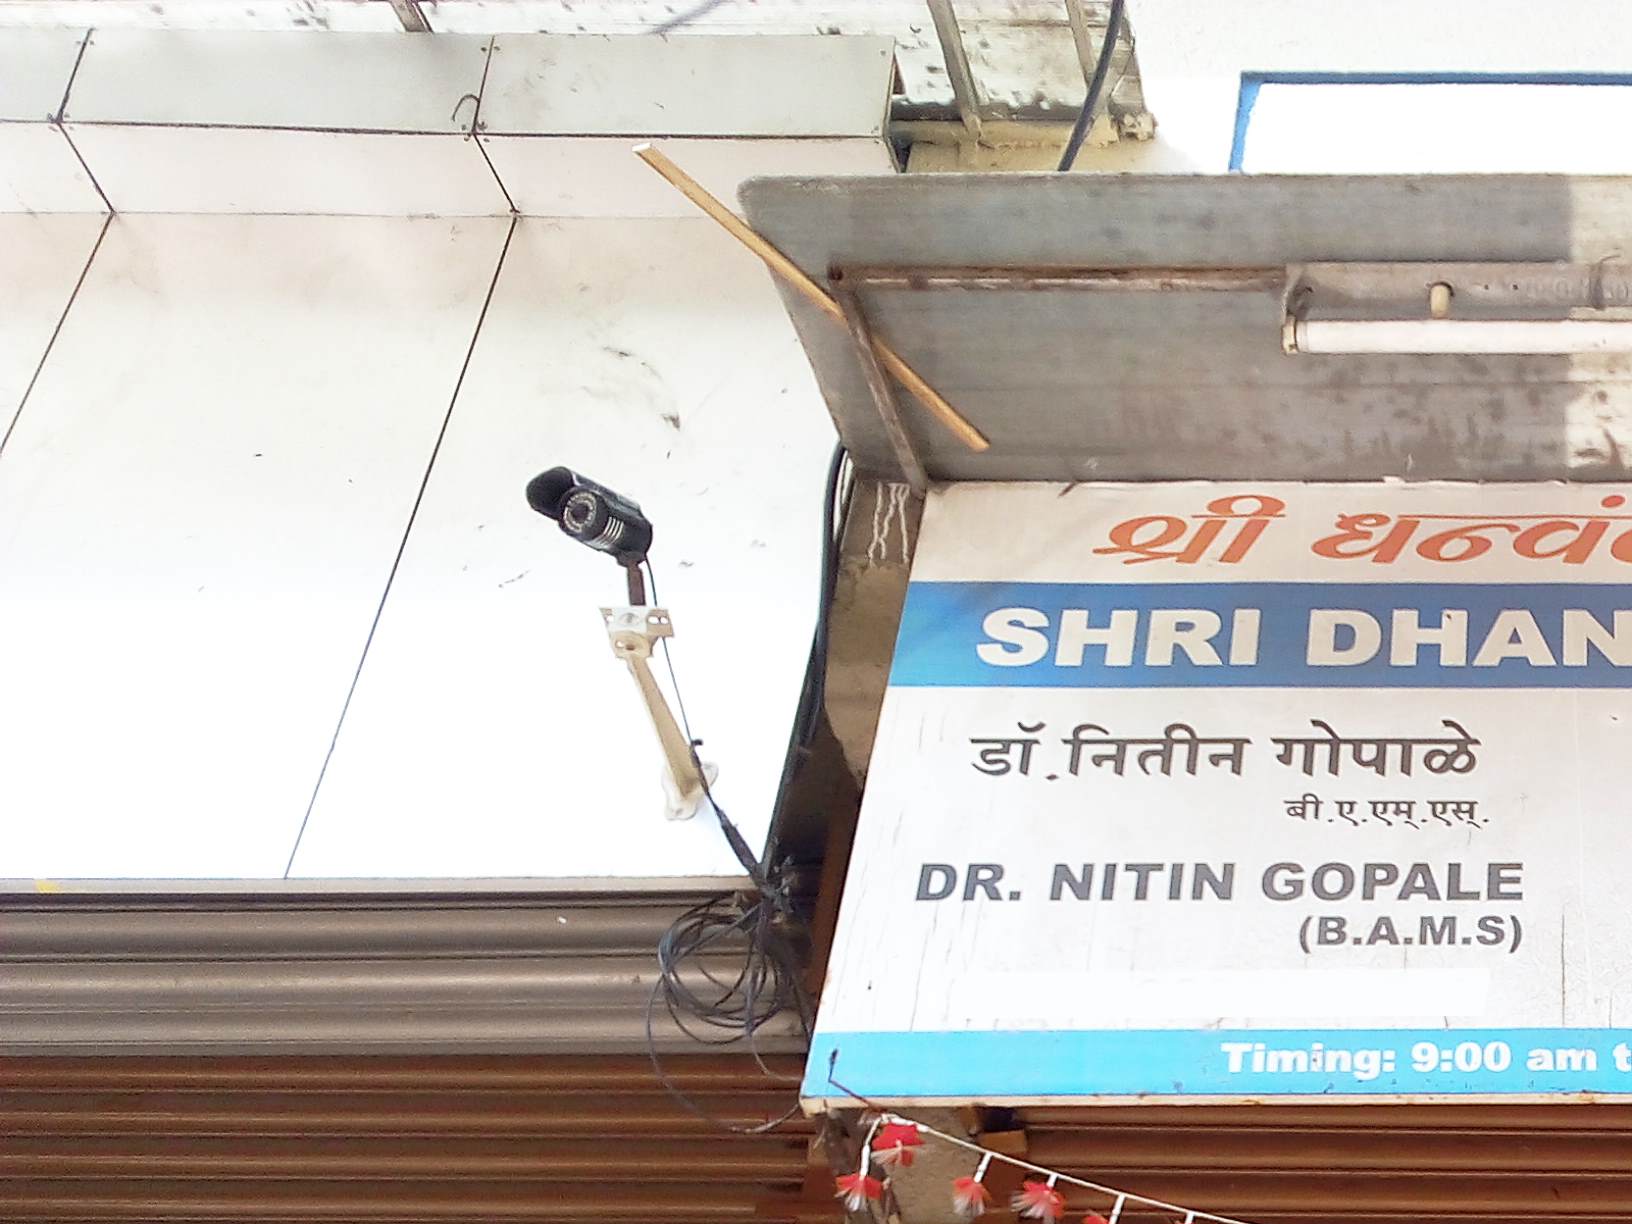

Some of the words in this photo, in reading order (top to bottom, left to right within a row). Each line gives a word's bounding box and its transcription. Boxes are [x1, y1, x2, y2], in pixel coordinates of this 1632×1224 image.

[1092, 493, 1285, 565] श्री
[976, 607, 1262, 668] SHRI
[1271, 719, 1482, 777] गोपाळे
[914, 862, 1022, 901] DR.
[1048, 862, 1235, 901] NITIN
[1260, 862, 1526, 902] GOPALE
[1298, 914, 1524, 954] (B.A.M.S)
[1220, 1041, 1396, 1081] Timing:
[1410, 1041, 1512, 1073] 9:00
[1526, 1049, 1599, 1073] am
